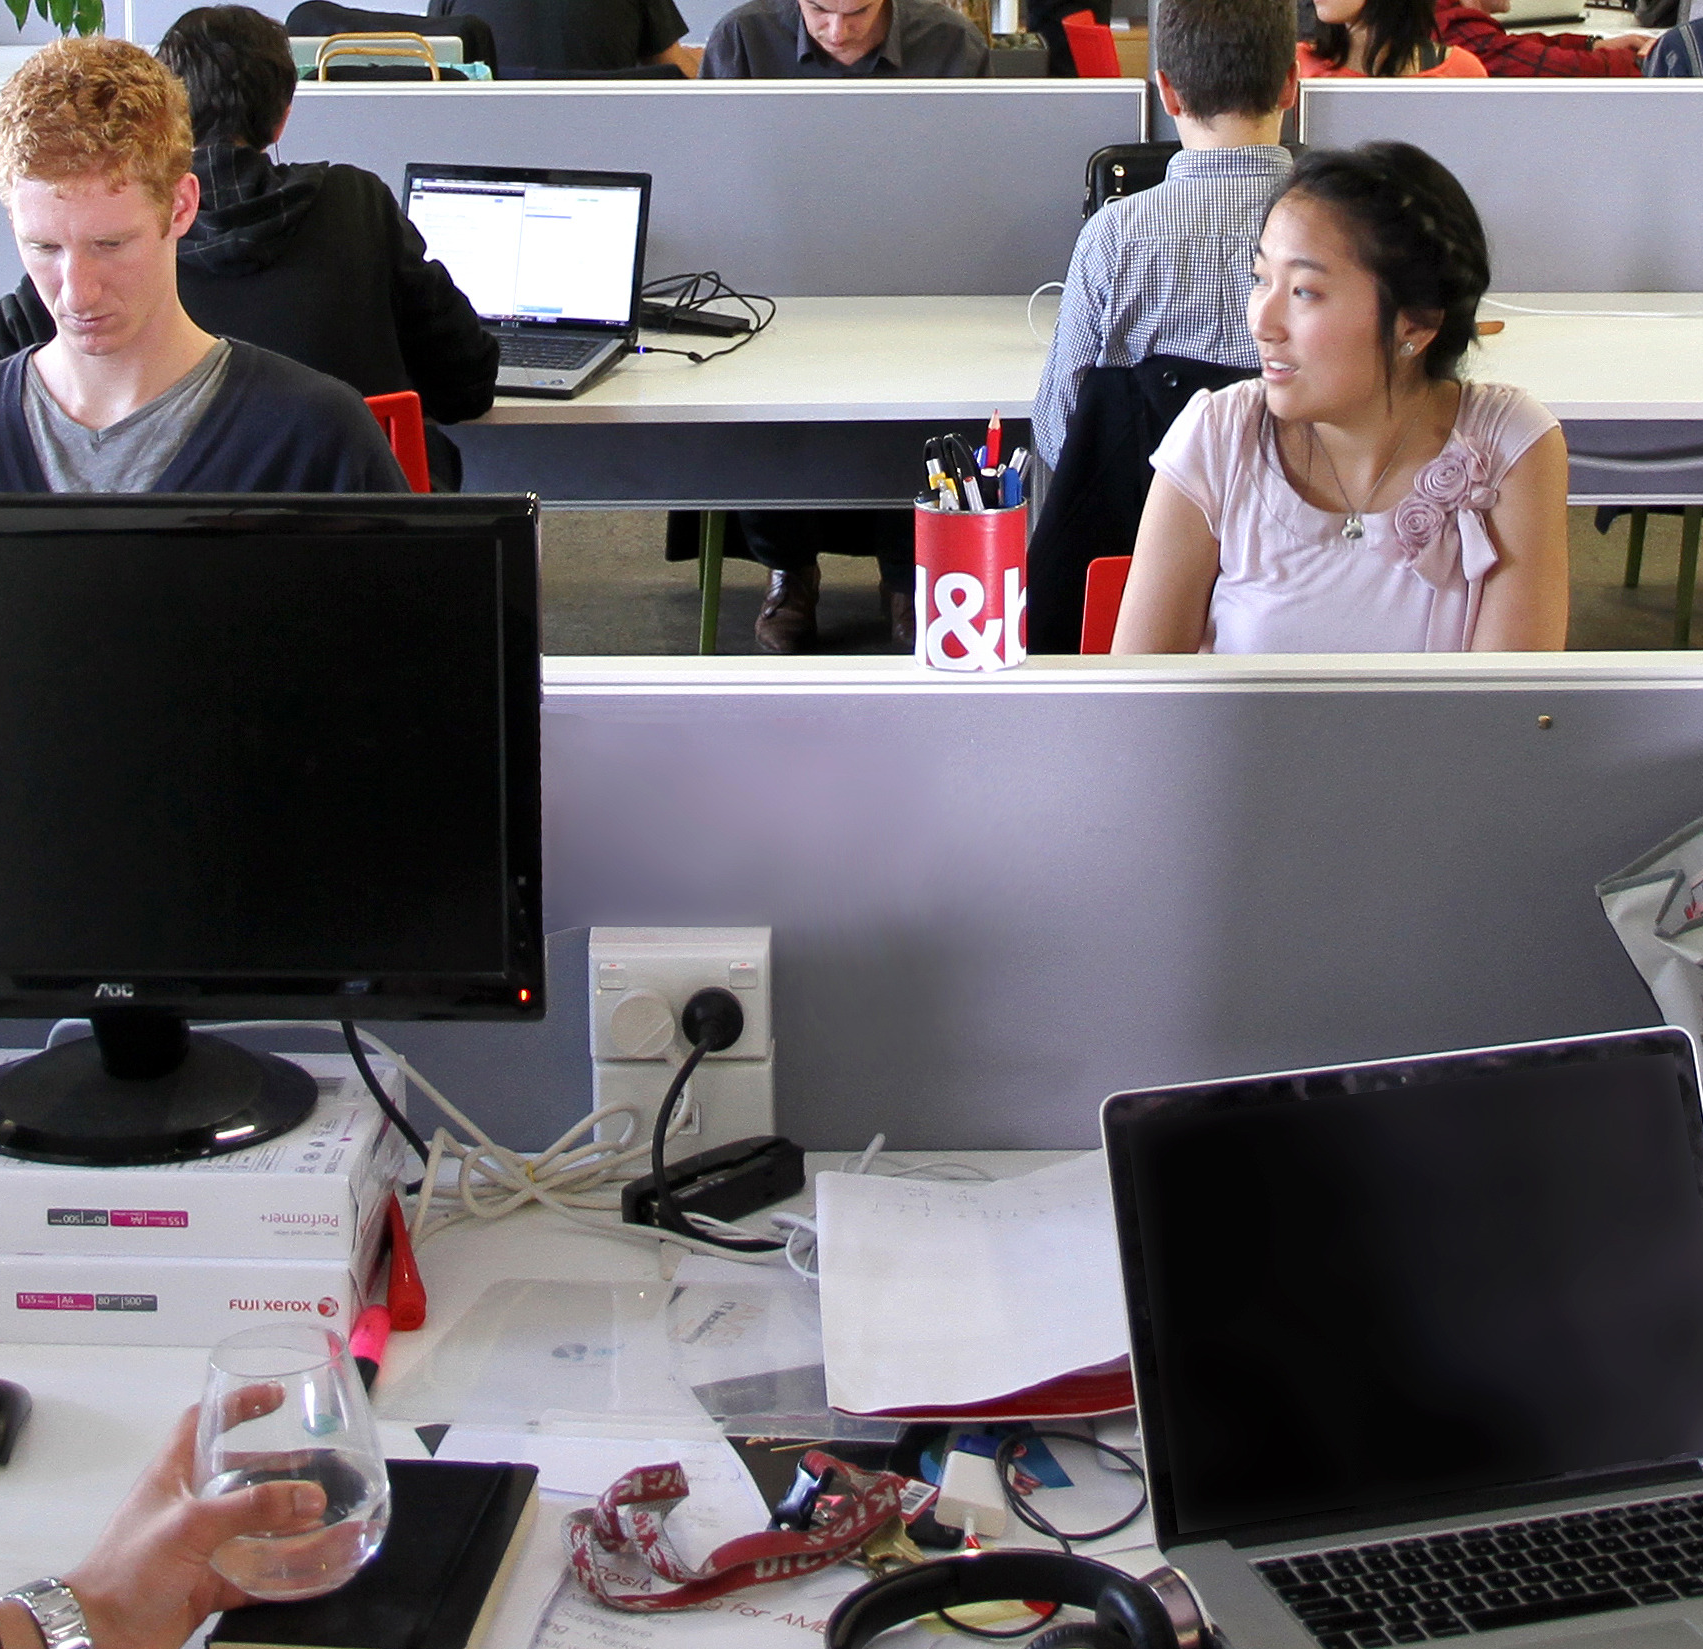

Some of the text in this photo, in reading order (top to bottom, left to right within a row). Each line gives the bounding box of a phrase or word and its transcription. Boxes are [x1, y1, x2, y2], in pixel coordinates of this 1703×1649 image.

[260, 1212, 339, 1228] Performer+
[228, 1298, 313, 1313] FUJI xerox
